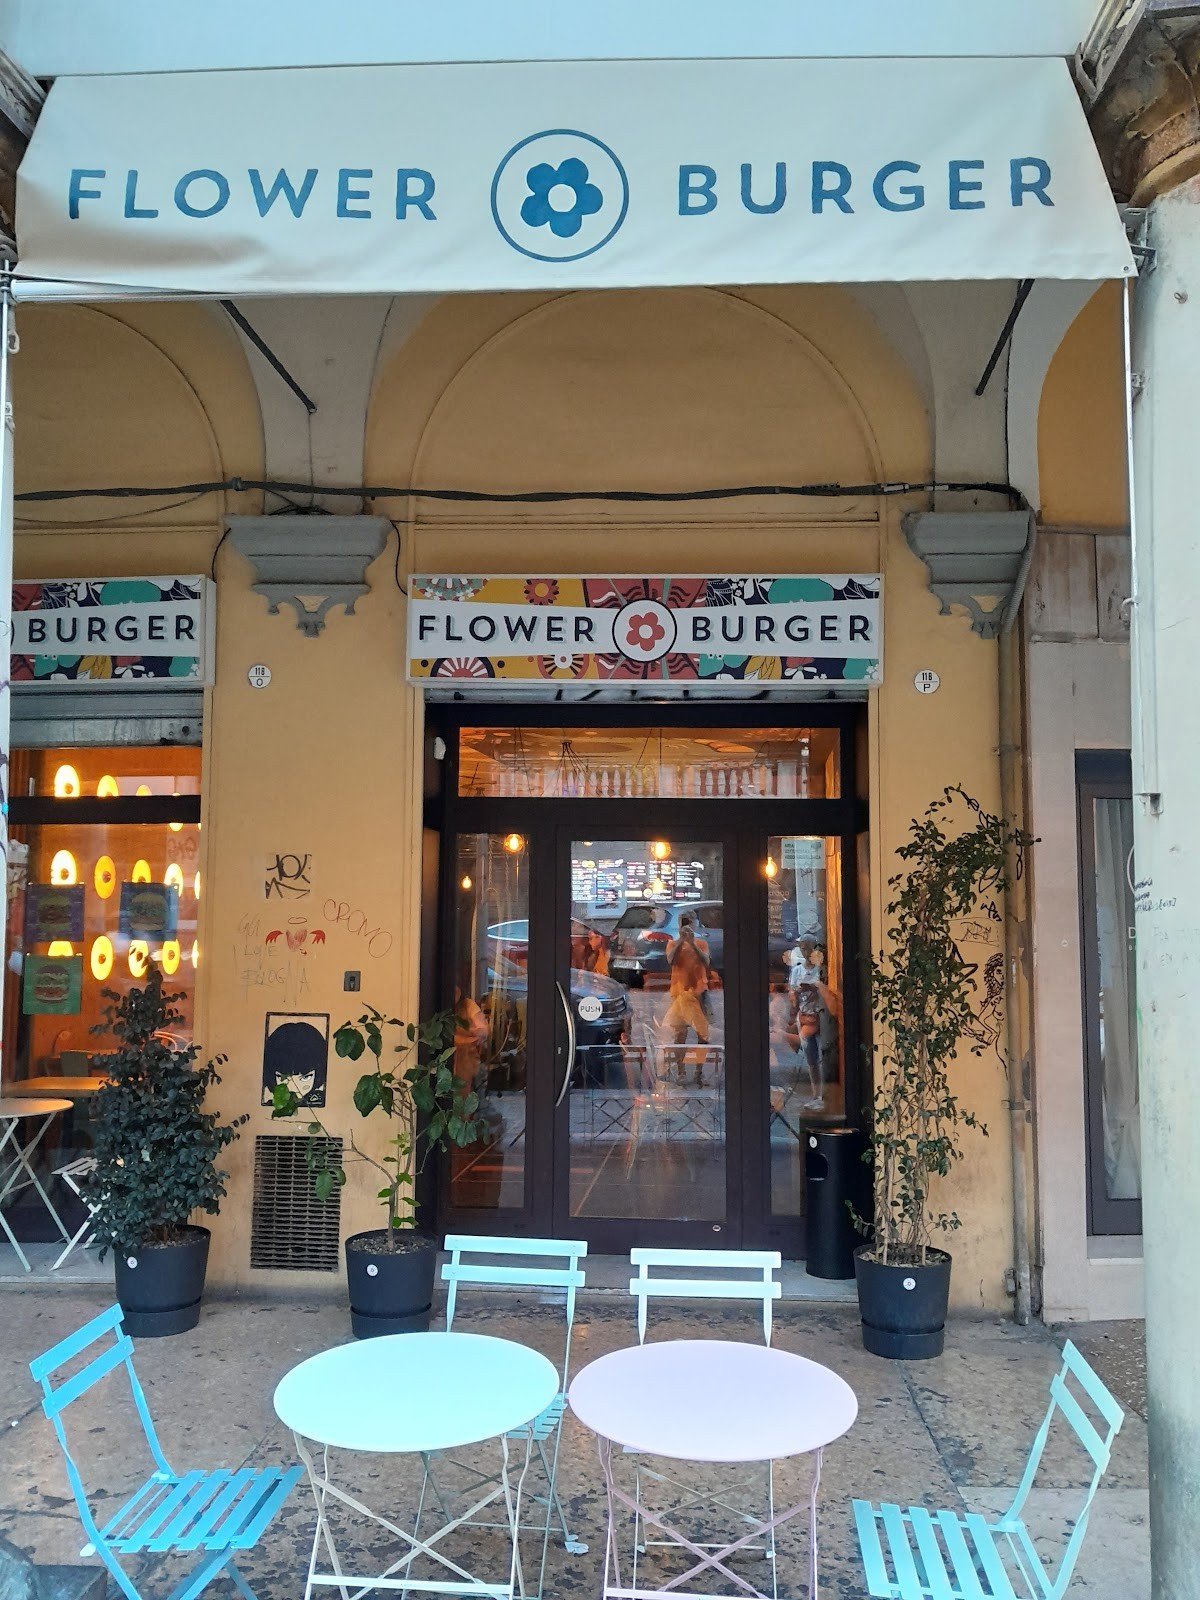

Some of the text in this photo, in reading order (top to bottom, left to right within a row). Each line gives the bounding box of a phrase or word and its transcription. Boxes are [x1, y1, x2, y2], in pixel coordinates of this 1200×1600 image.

[69, 157, 1055, 220] FLOWER BURGER
[28, 614, 195, 643] BURGER
[418, 615, 871, 643] FLOWER BURGER
[923, 683, 931, 692] P
[580, 1005, 601, 1013] PUSH
